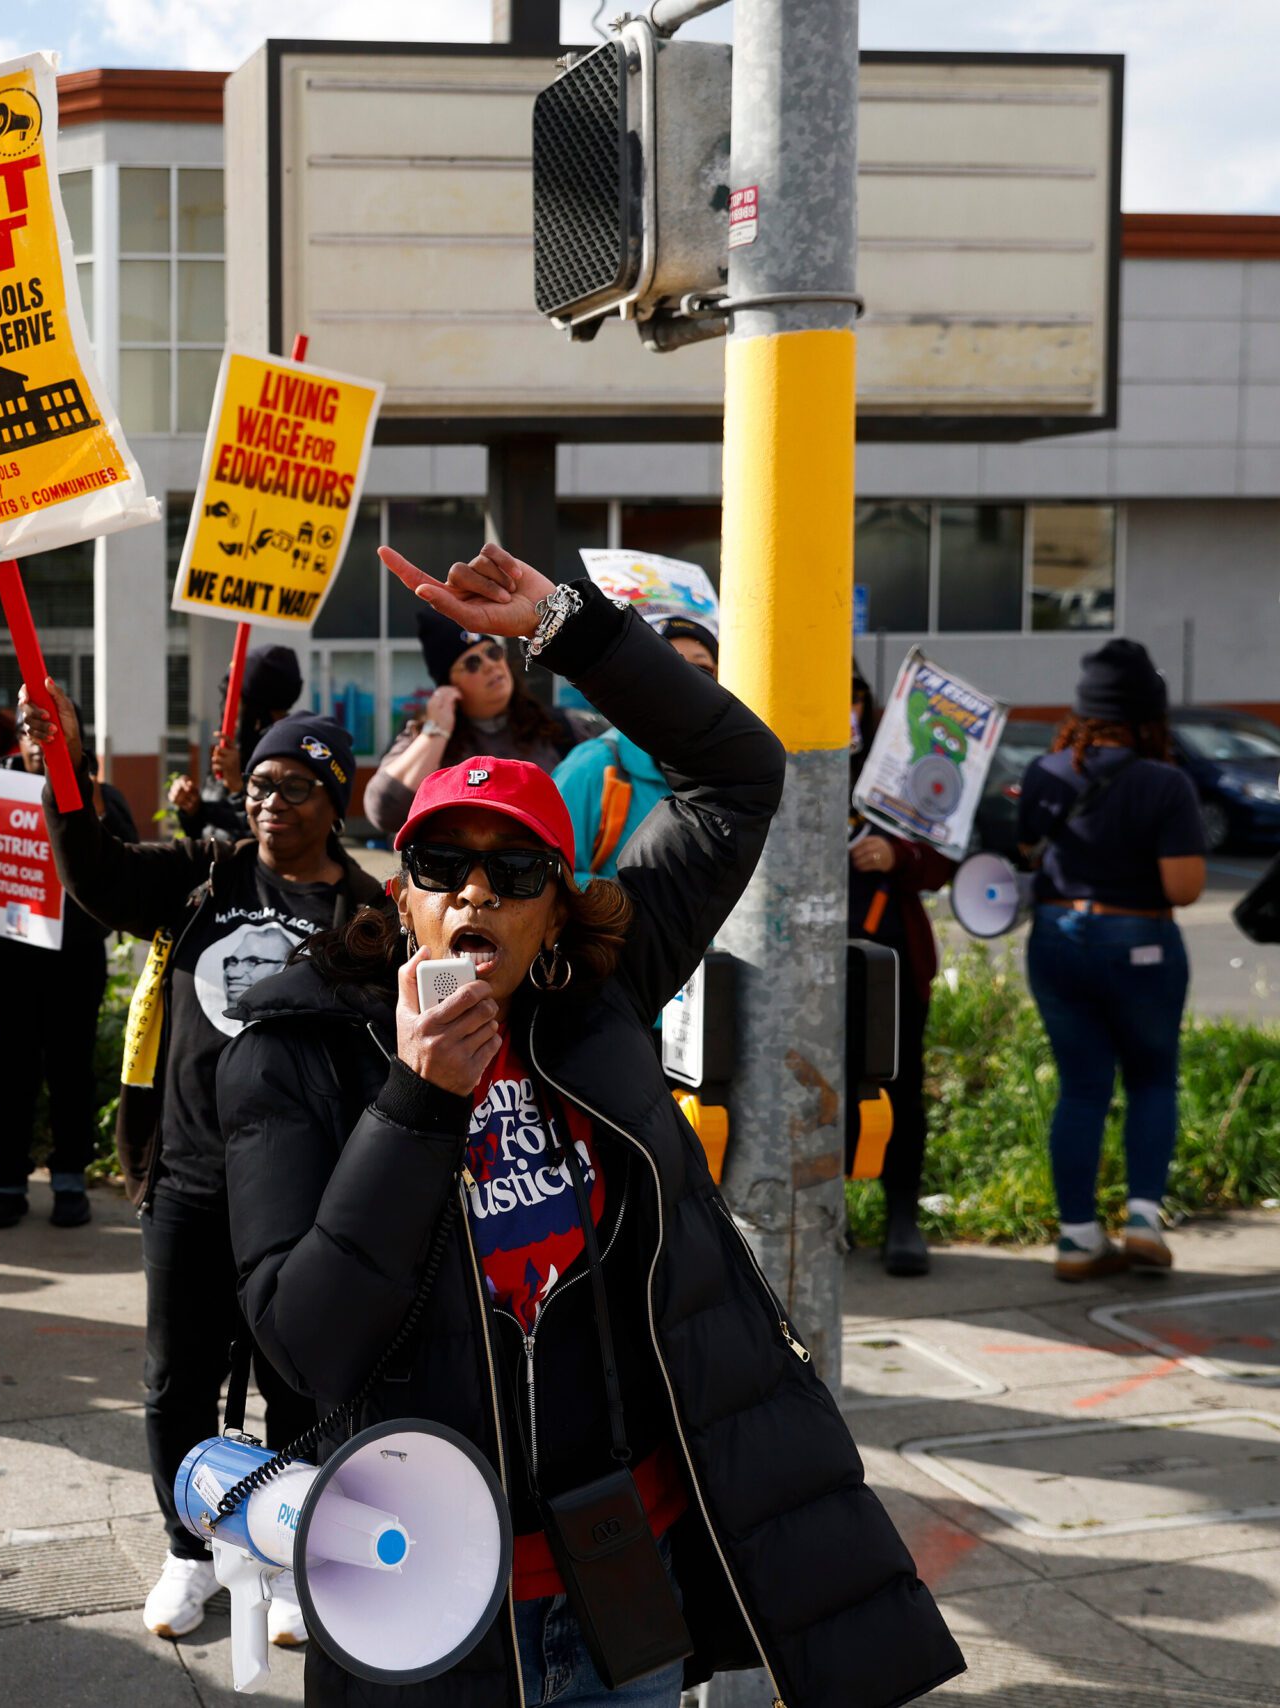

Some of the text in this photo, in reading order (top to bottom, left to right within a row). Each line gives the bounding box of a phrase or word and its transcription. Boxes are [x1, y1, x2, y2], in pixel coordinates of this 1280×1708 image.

[744, 189, 756, 204] ID
[259, 370, 340, 425] LIVING
[237, 405, 336, 464] WAGE FOR
[20, 495, 31, 509] &
[31, 467, 119, 504] COMMUNITIES
[214, 444, 356, 510] EDUCATORS
[187, 568, 322, 618] WE CAN'T WAIT
[467, 769, 489, 786] P
[9, 809, 39, 831] ON
[19, 867, 44, 883] OUR
[215, 906, 276, 924] MALCOLM
[500, 1116, 562, 1161] For
[461, 1140, 596, 1219] ustice!
